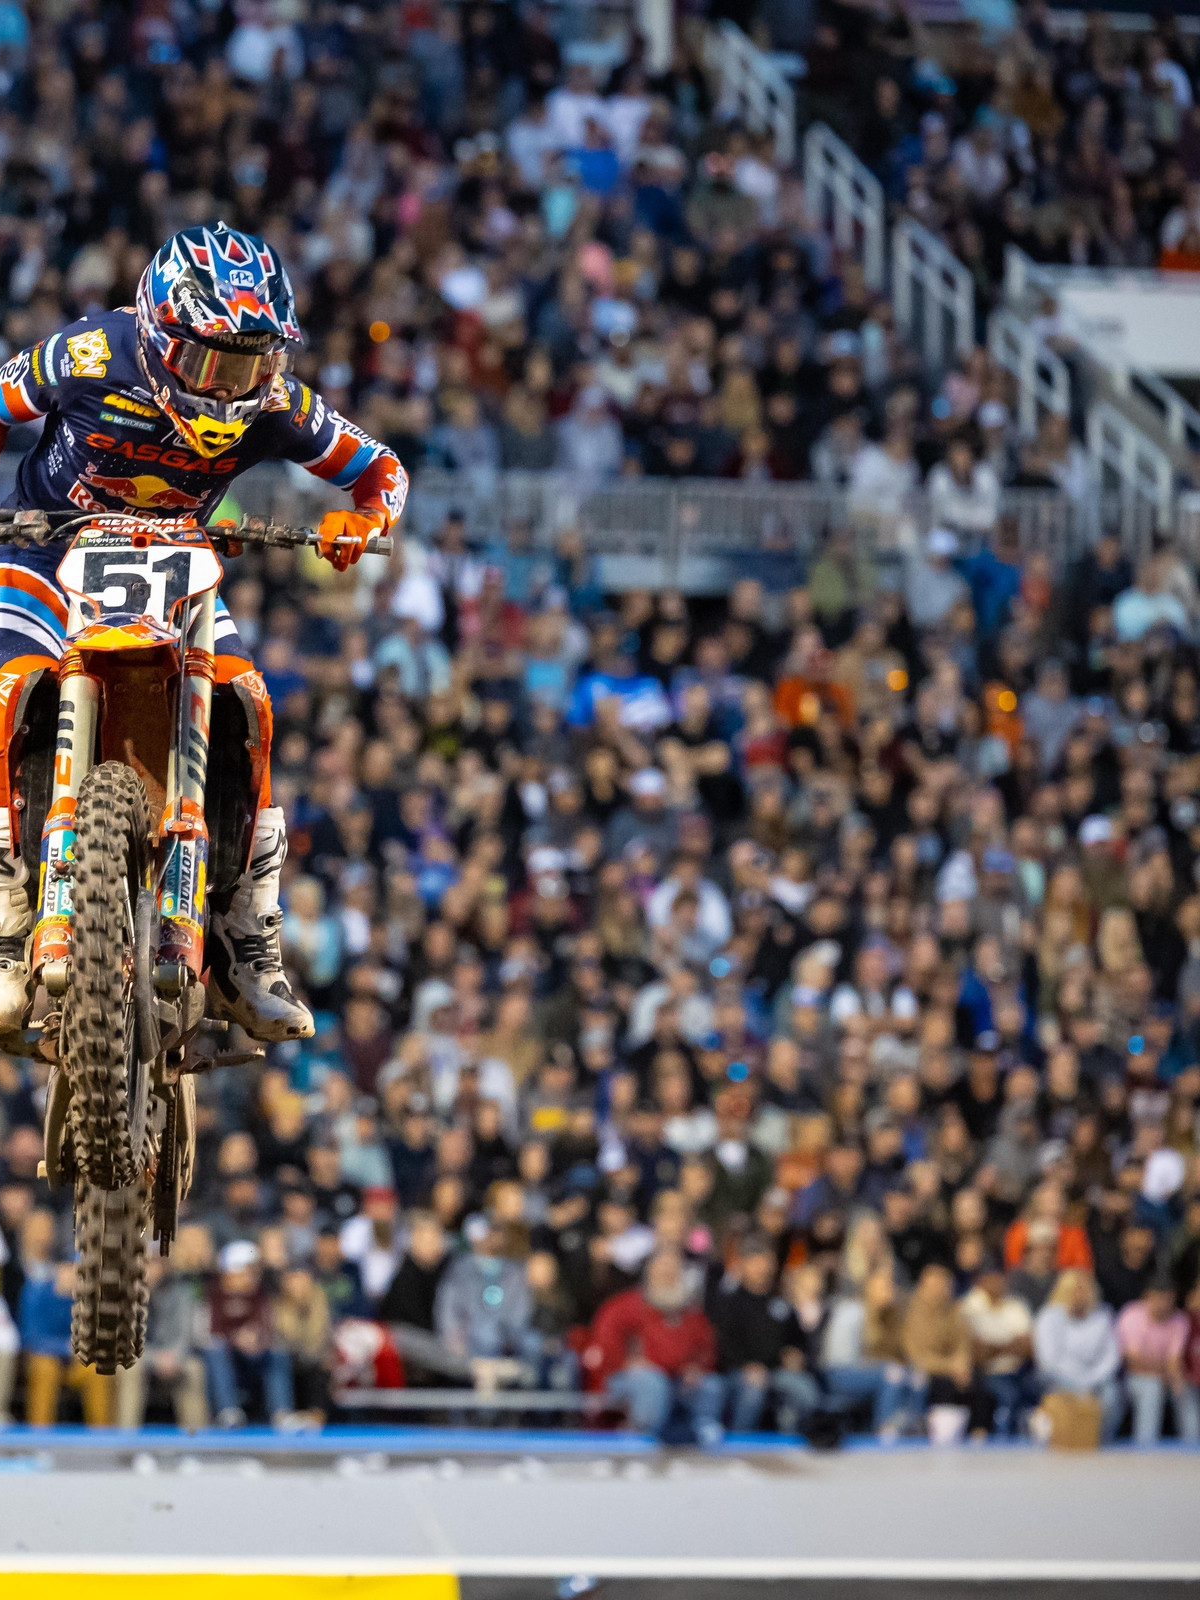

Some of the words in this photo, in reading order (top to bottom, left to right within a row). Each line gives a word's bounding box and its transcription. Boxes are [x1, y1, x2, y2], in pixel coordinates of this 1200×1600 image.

[231, 271, 253, 285] PPG
[113, 415, 154, 431] MOTOREX
[86, 432, 238, 475] GASGAS
[80, 551, 191, 622] 51
[180, 845, 192, 914] DUNLOP
